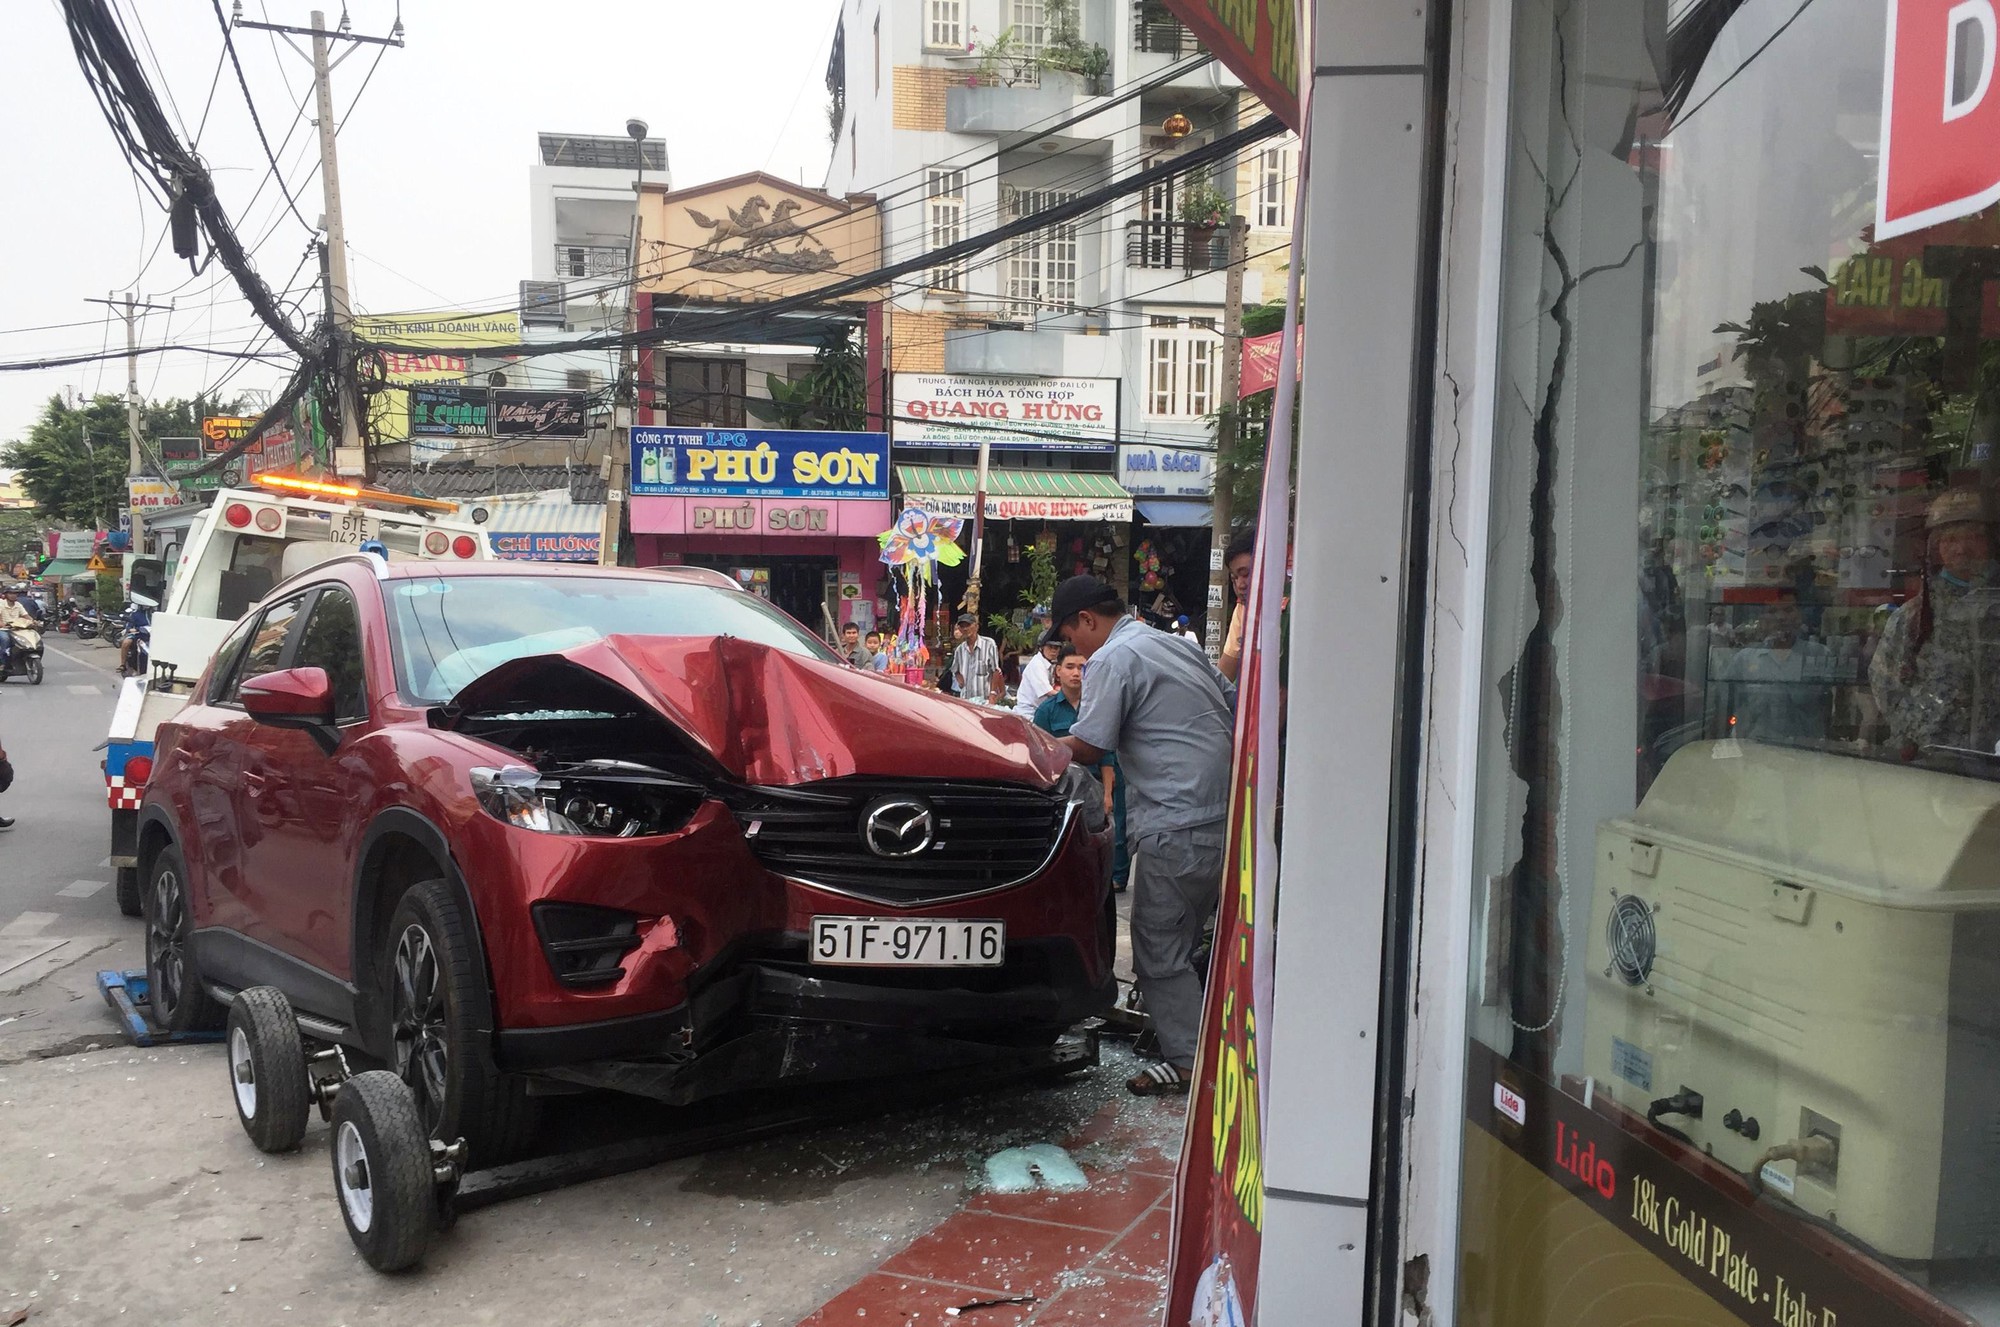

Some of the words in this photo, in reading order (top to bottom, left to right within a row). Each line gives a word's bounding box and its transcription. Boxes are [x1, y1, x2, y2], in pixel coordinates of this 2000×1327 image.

[406, 322, 434, 334] KINH
[438, 322, 480, 333] DOANH
[483, 320, 516, 333] VÀNG
[935, 386, 972, 397] BÁCH
[976, 386, 1005, 398] HÓA
[1008, 387, 1044, 399] TỔNG
[1047, 390, 1075, 401] HỢP
[433, 401, 487, 425] CHÂU
[906, 400, 1009, 420] QUANG
[1021, 399, 1104, 422] HÙNG
[635, 431, 661, 444] CÔNG
[663, 434, 676, 445] TY
[677, 434, 703, 446] TNHH
[706, 431, 748, 447] LPG
[686, 441, 780, 484] PHÚ
[792, 447, 880, 486] SƠN
[1126, 449, 1158, 472] NHÀ
[1162, 451, 1200, 473] SÁCH
[131, 494, 159, 507] CẦM
[163, 494, 181, 506] ĐỒ
[925, 498, 940, 513] CỬA
[941, 499, 960, 514] HÀNG
[999, 501, 1046, 518] QUANG
[1050, 498, 1088, 517] HÙNG
[342, 516, 369, 533] 51E
[693, 501, 756, 530] PHÚ
[768, 505, 829, 531] SƠN
[497, 533, 532, 551] CHÍ
[818, 923, 998, 960] 51F-971.16
[1500, 1088, 1519, 1113] Lido
[1555, 1120, 1616, 1200] Lido
[1631, 1174, 1660, 1235] 18k
[1664, 1196, 1707, 1267] Gold
[1709, 1224, 1758, 1304] Plate
[1773, 1274, 1817, 1327] Italy
